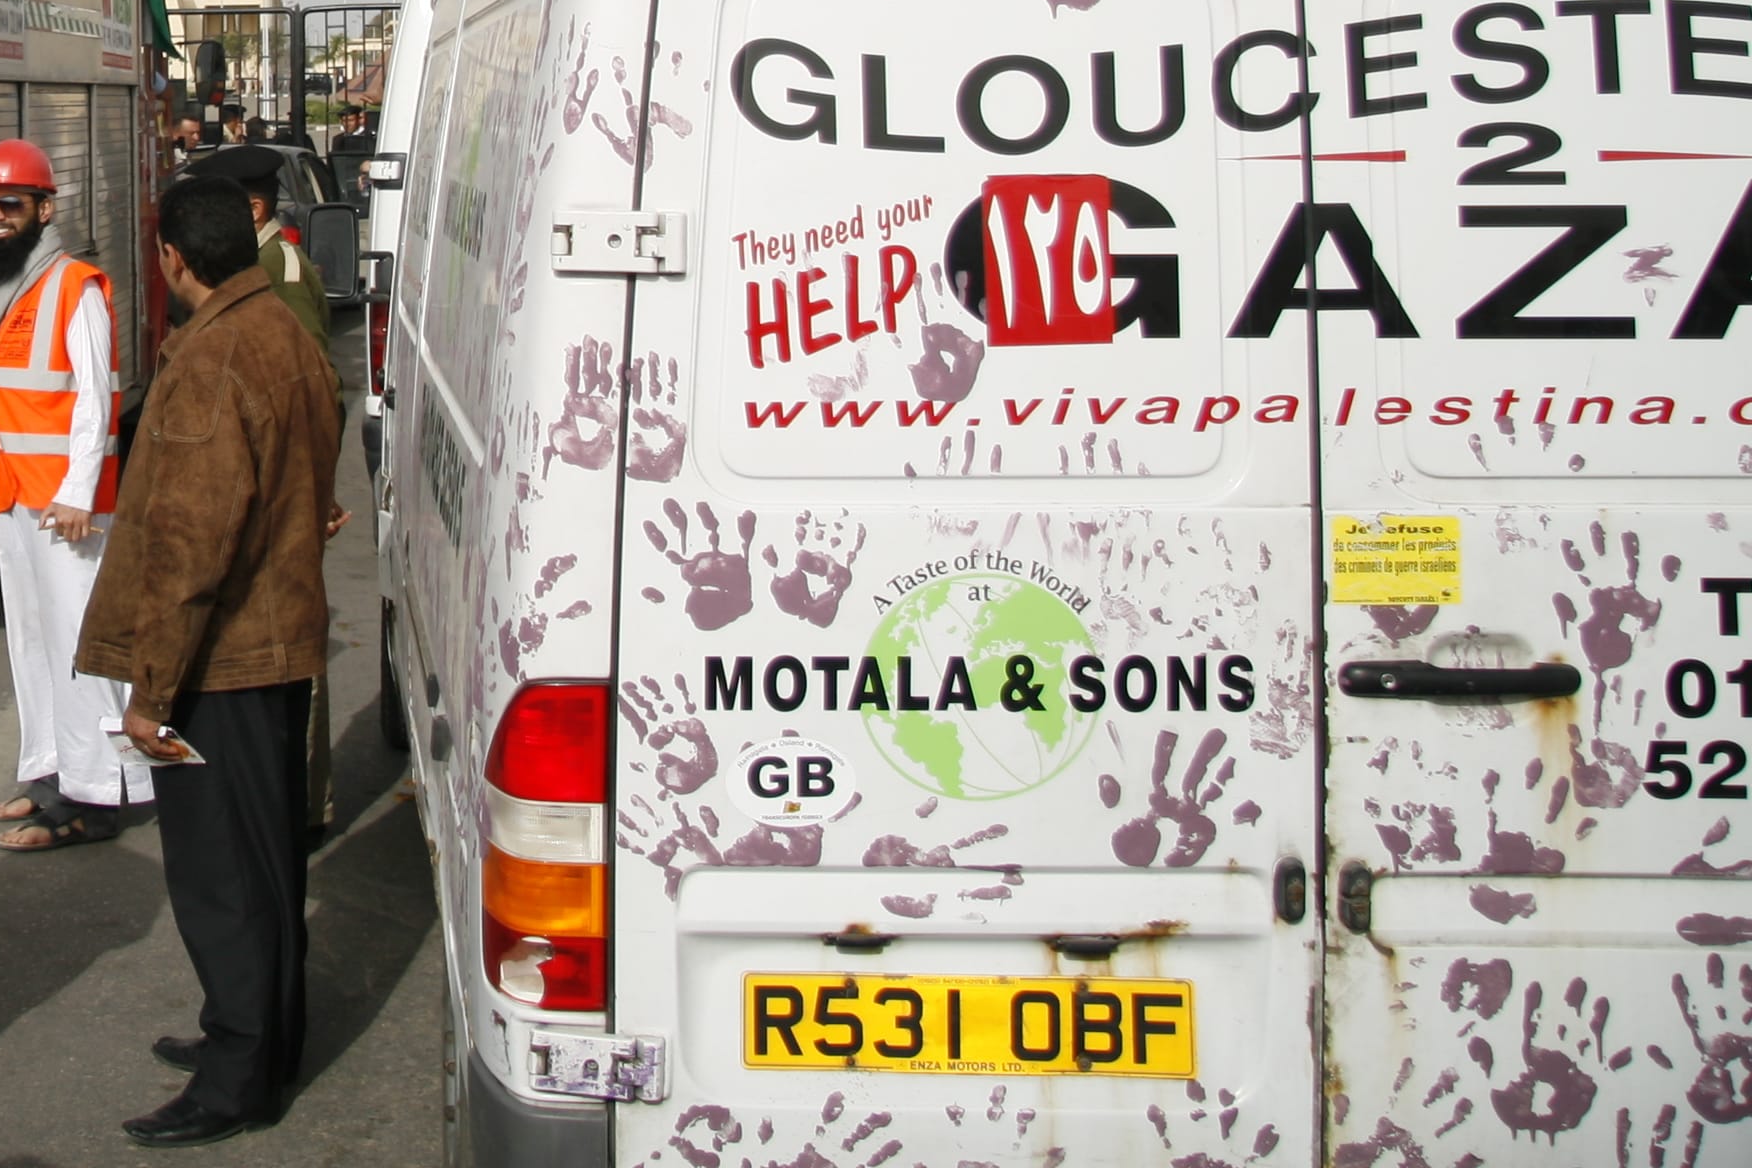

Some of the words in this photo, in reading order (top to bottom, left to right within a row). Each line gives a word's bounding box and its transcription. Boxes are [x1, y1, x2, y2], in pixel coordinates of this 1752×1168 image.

[1455, 122, 1567, 186] 2
[731, 229, 796, 271] They
[804, 204, 865, 253] need
[877, 194, 934, 242] your
[744, 244, 918, 369] HELP
[1379, 523, 1445, 535] efuse
[1401, 537, 1416, 552] les
[872, 594, 893, 616] A
[886, 558, 949, 597] Taste
[954, 548, 980, 572] of
[986, 550, 1024, 575] the
[1029, 560, 1093, 616] World
[1333, 558, 1347, 573] des
[1383, 556, 1393, 573] de
[1394, 561, 1419, 576] guerre
[967, 584, 992, 602] at
[704, 655, 979, 713] MOTALA
[999, 654, 1047, 713] &
[1068, 654, 1256, 714] SONS
[747, 755, 836, 799] GB
[753, 984, 961, 1060] R531
[909, 1060, 943, 1072] ENZA
[946, 1061, 997, 1073] MOTORS
[1001, 1061, 1026, 1073] LTD.
